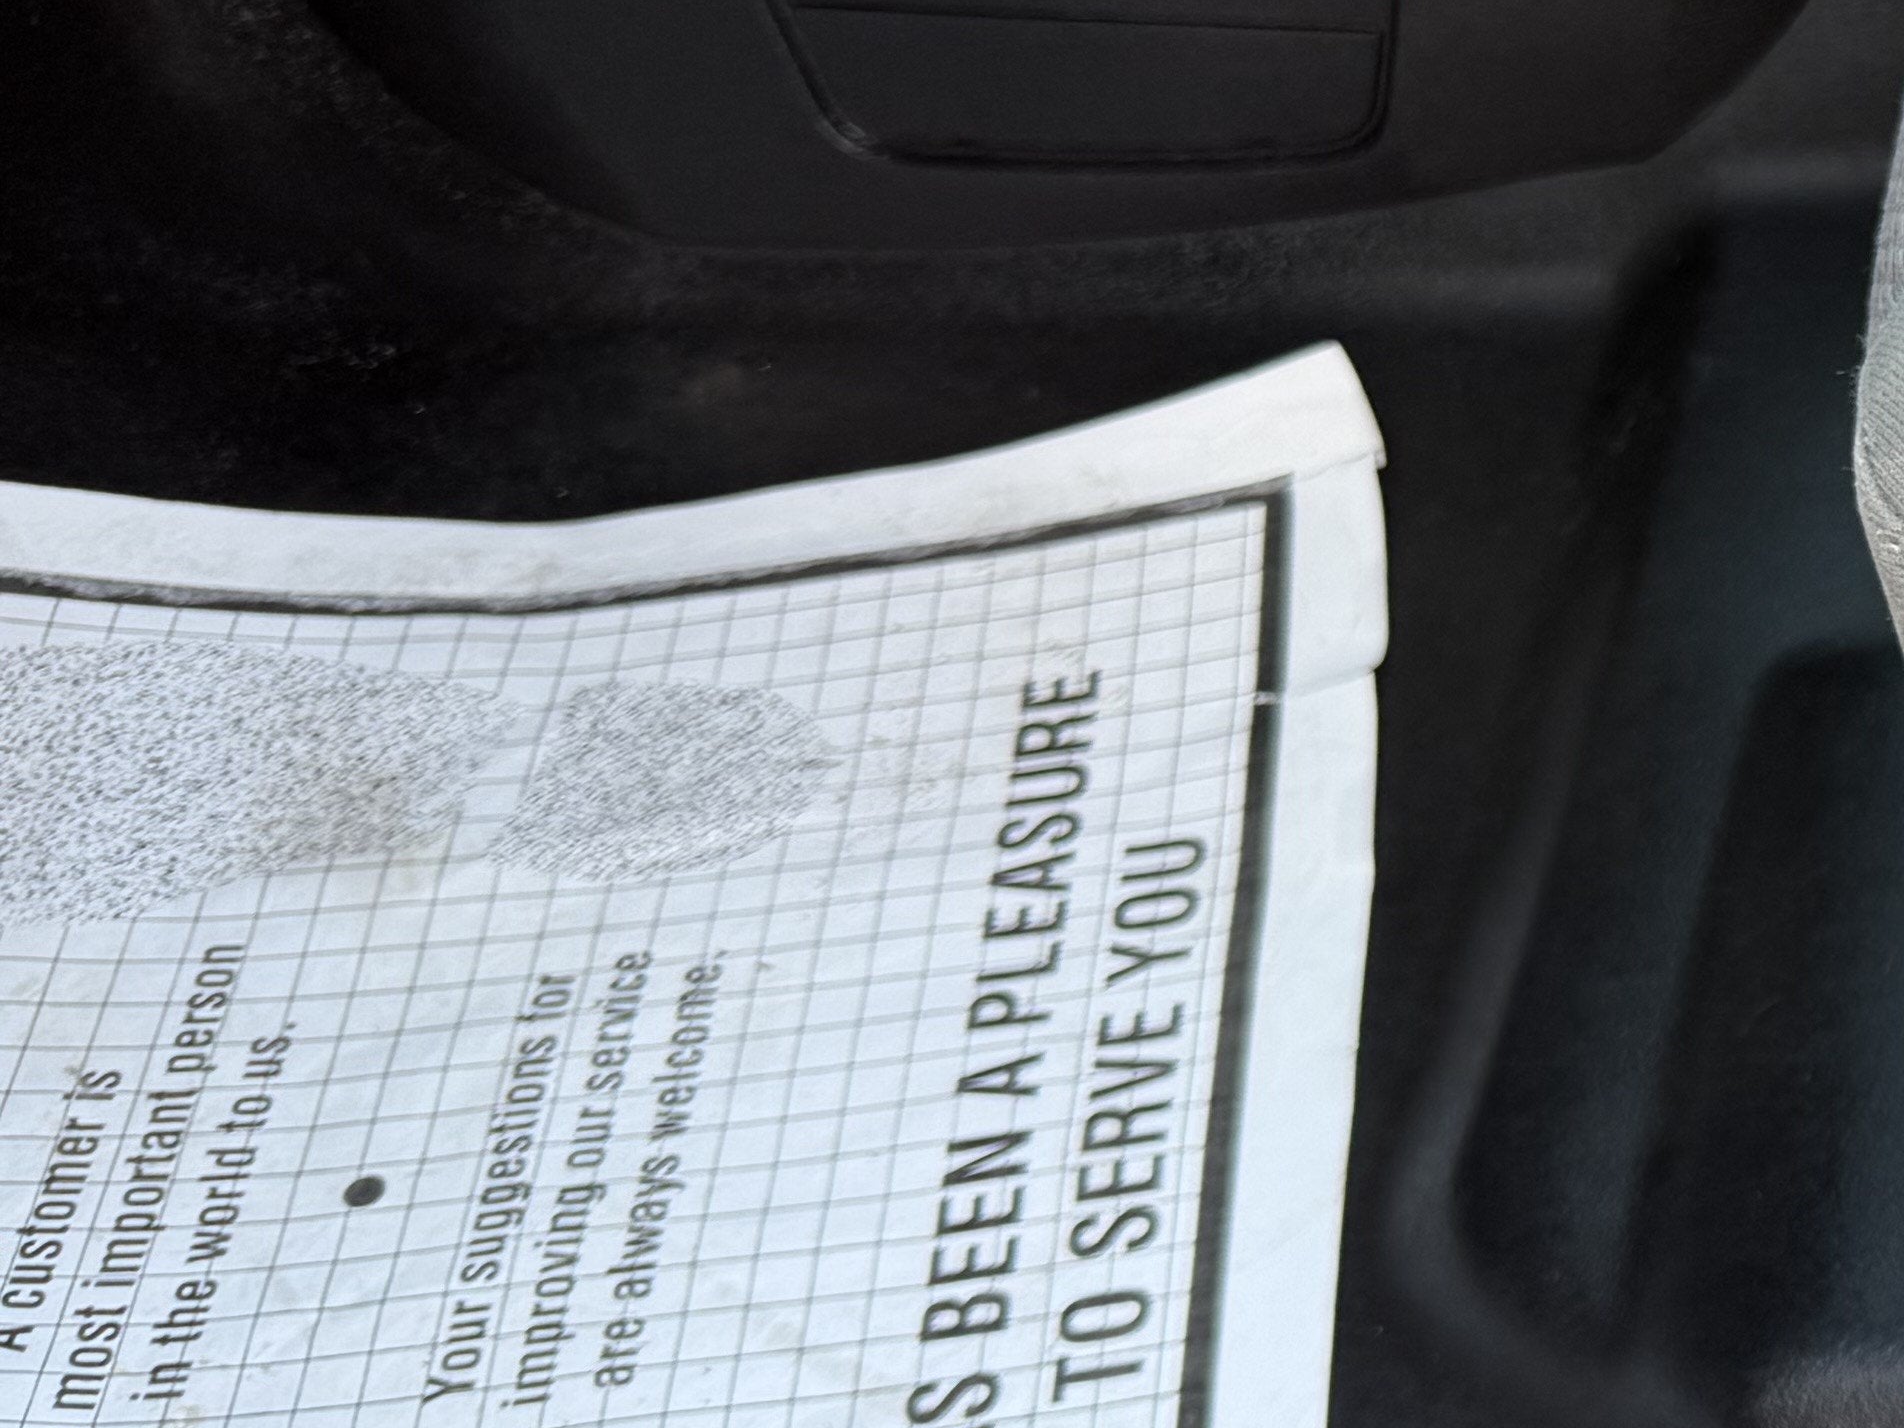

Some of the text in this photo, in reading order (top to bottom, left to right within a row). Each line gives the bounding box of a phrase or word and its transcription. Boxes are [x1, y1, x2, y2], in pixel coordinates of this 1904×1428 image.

[166, 943, 244, 1073] person
[967, 668, 1101, 1030] PLEASURE
[0, 1069, 123, 1353] A customer is
[82, 1087, 197, 1287] important
[131, 1021, 296, 1403] in the world to us.
[422, 974, 577, 1405] Your suggestions for
[501, 950, 651, 1408] improving our service
[595, 949, 729, 1388] are always welcome.
[956, 1053, 1044, 1095] A
[1051, 837, 1206, 1402] TO SERVE YOU
[53, 1303, 126, 1411] most
[920, 1131, 1032, 1343] BEEN
